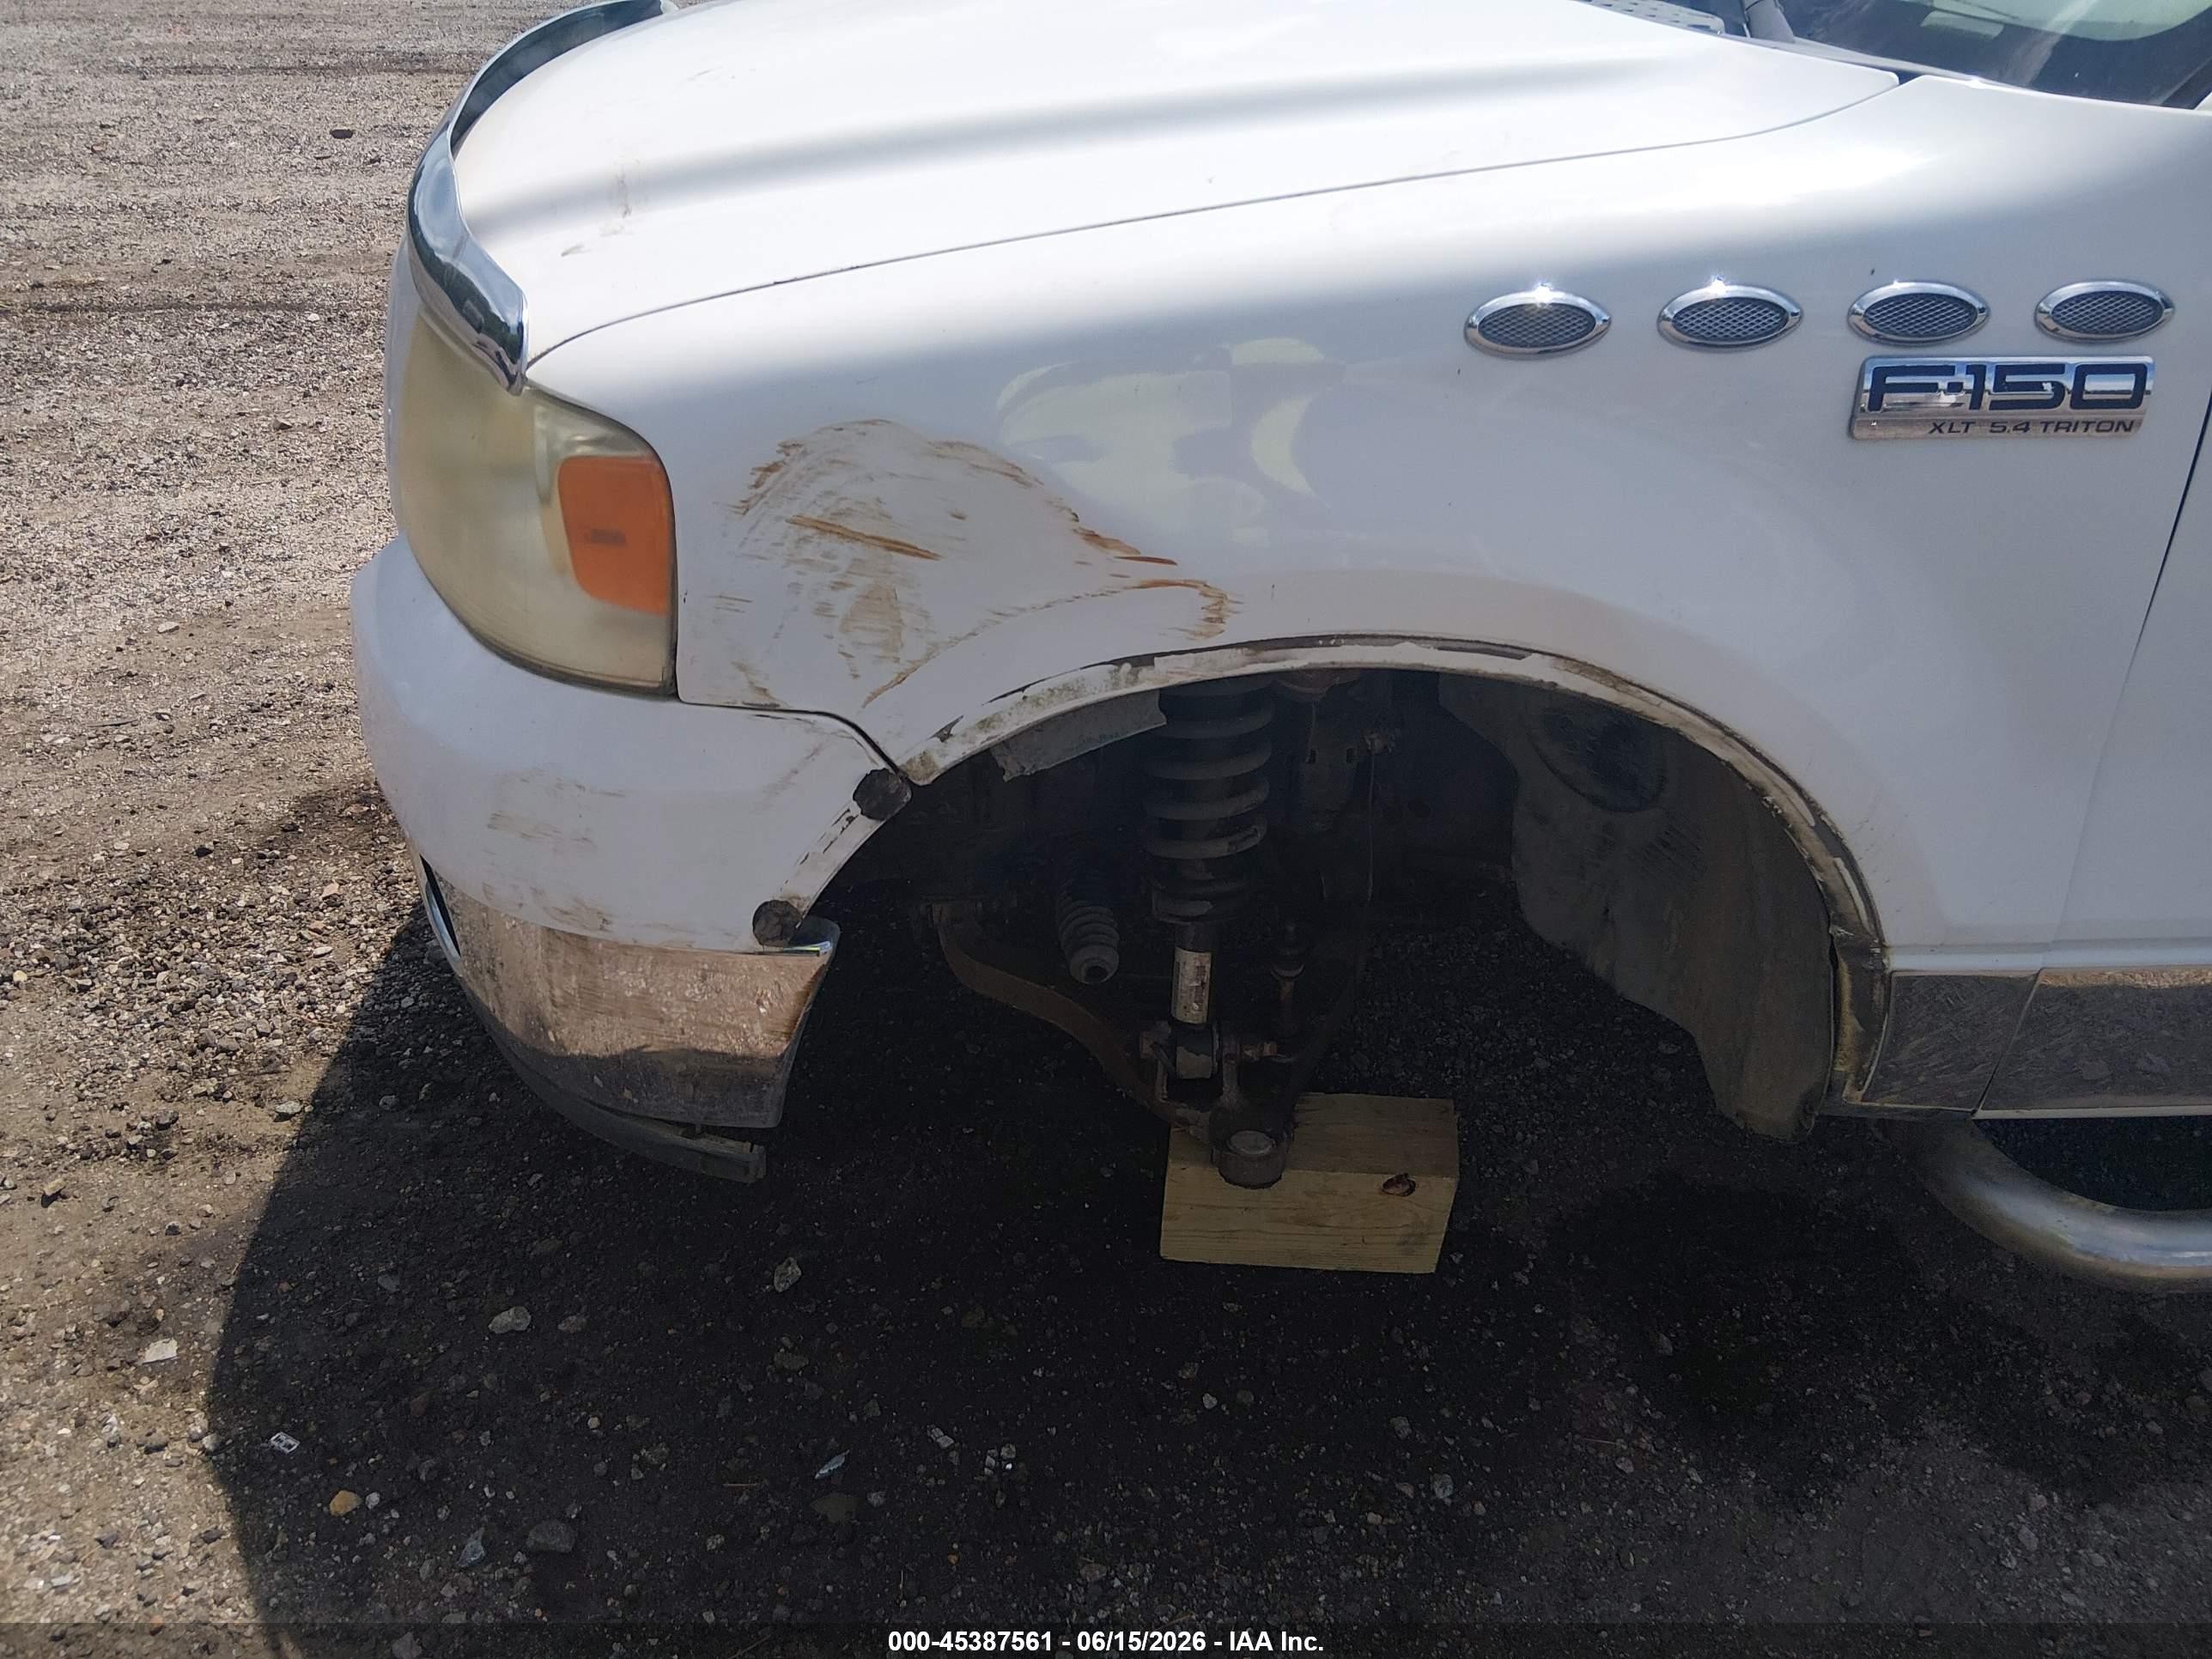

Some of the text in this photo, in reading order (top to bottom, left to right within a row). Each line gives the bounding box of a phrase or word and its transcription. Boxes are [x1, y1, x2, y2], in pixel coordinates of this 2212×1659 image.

[1867, 362, 2148, 411] F-150
[1928, 419, 2135, 434] XLT 5.4 TRITON
